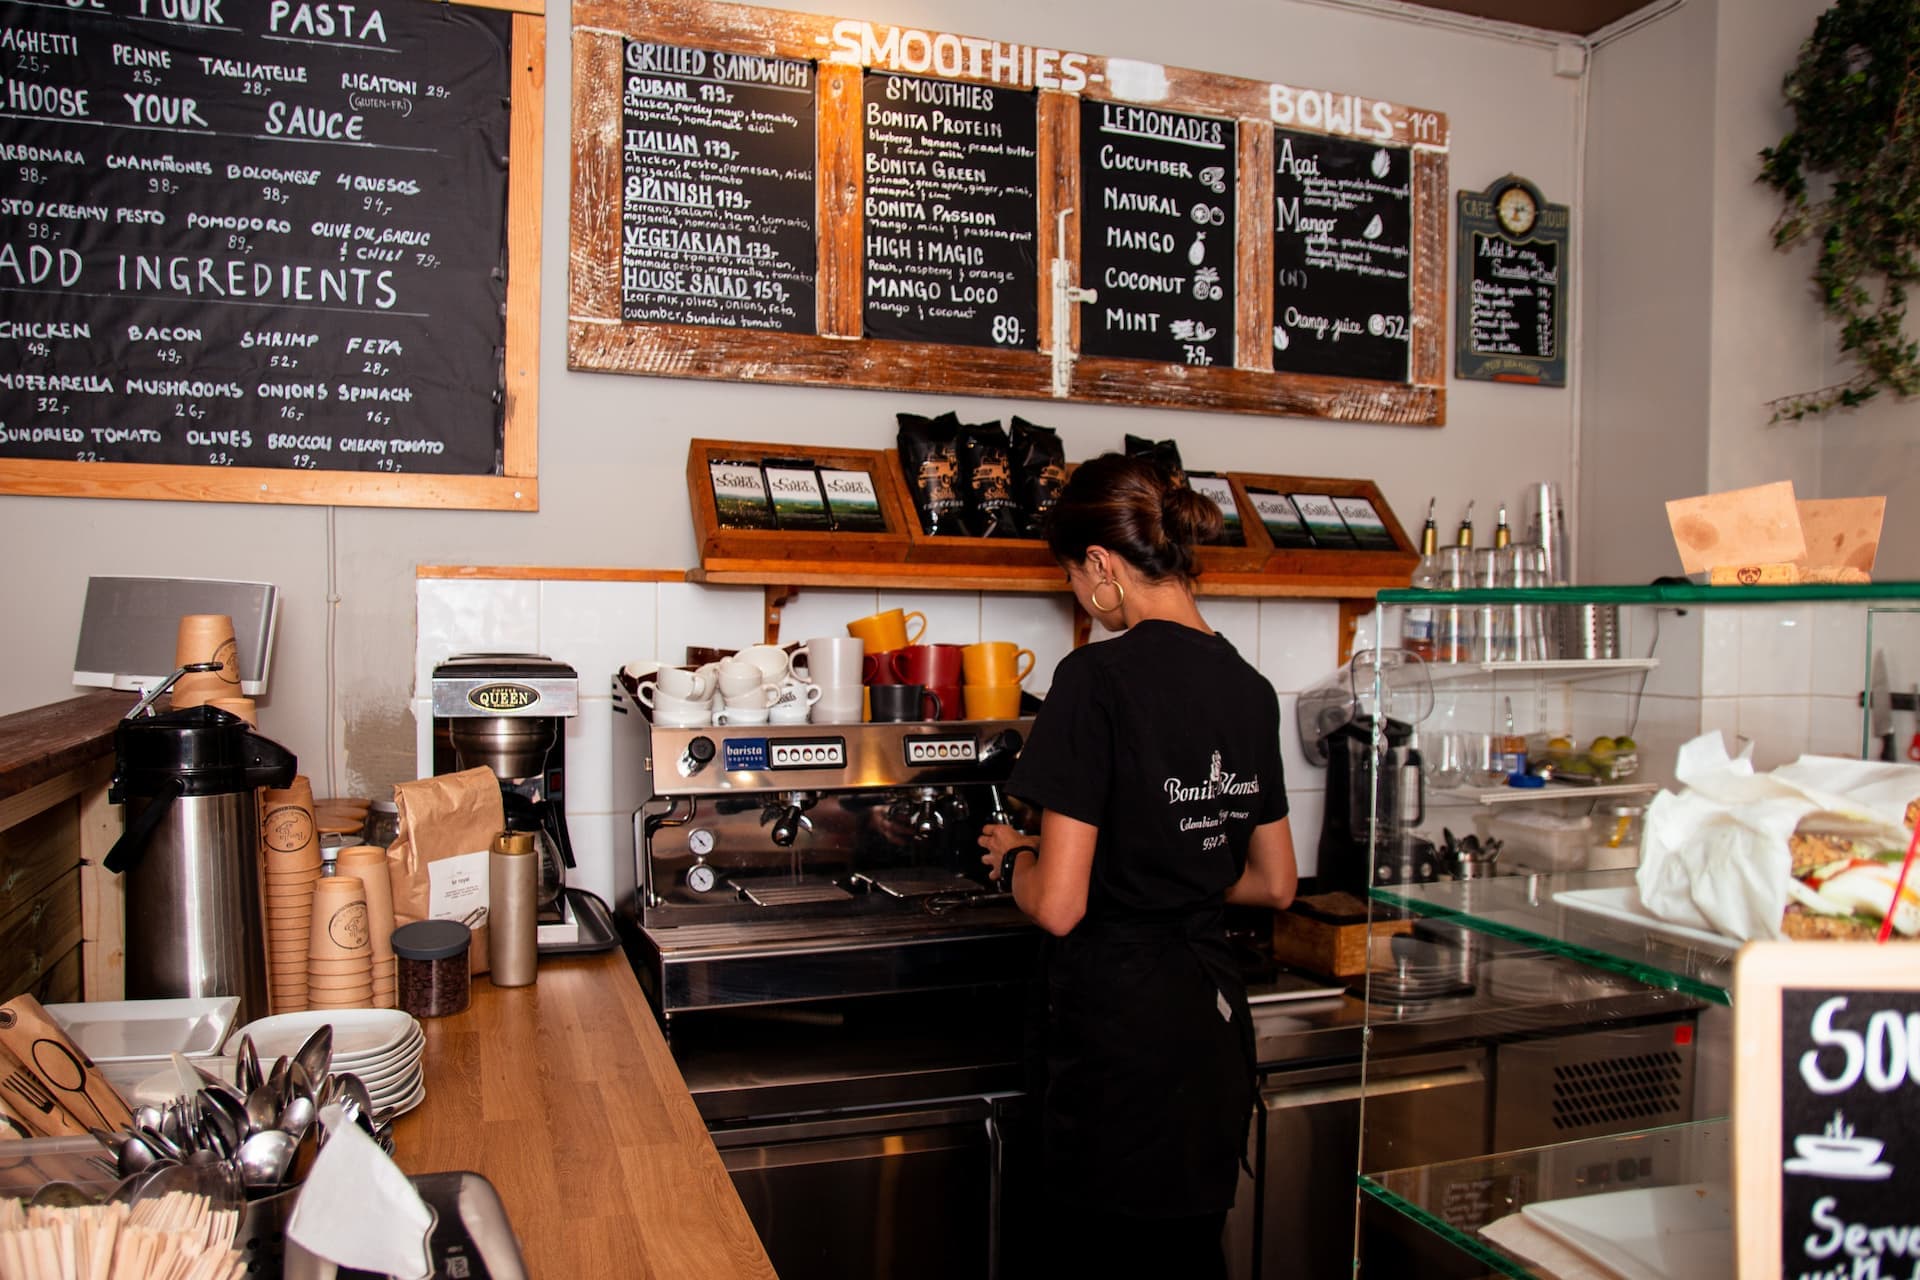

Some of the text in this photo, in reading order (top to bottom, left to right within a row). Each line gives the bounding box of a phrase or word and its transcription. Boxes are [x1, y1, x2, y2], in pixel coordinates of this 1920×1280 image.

[270, 0, 386, 43] PASTA
[0, 28, 78, 56] AGHETTI
[113, 44, 171, 68] PENNE
[199, 57, 307, 83] TAGLIATELLE
[342, 73, 417, 95] RIGATONI
[626, 42, 807, 87] GRILLED SANDWICH
[628, 77, 687, 98] CUBAN
[886, 76, 993, 111] SMOOTHIES
[0, 79, 364, 140] HOOSE YOUR SAUCE
[1103, 105, 1221, 144] LEMONADES
[625, 129, 698, 153] ITALIAN
[107, 155, 212, 175] CHAMPIÑONES
[227, 165, 321, 185] BOLOGNESE
[355, 176, 420, 194] QUESOS
[700, 171, 743, 185] tomato
[625, 175, 713, 206] SPANISH
[117, 208, 165, 224] PESTO
[188, 213, 291, 233] POMODORO
[312, 222, 351, 238] OLIVE
[1277, 197, 1337, 245] Mango
[625, 226, 741, 255] VEGETARIAN
[867, 236, 984, 265] HIGH MAGIC
[1107, 227, 1174, 253] MANGO
[357, 248, 403, 262] CHILI
[0, 243, 397, 308] ADD INGREDIENTS
[624, 268, 685, 293] HOUSE
[690, 273, 748, 298] SALAD
[868, 277, 998, 303] MANGO LOCO
[969, 270, 1015, 283] orange
[1105, 267, 1185, 294] COCONUT
[741, 317, 782, 328] tomato
[870, 301, 976, 318] mango coconut
[1106, 308, 1160, 332] MINT
[1285, 306, 1329, 340] Orange
[0, 321, 402, 355] CHICKEN BACON SHRIMP FETA
[0, 373, 412, 402] MOZZARELLA MUSHROOMS ONIONS SPINACH
[0, 422, 444, 455] SUNDRIED TOMATO OLIVES BROCCOLI CHERRY TOMATO
[480, 692, 528, 706] QUEEN
[726, 745, 763, 756] barista
